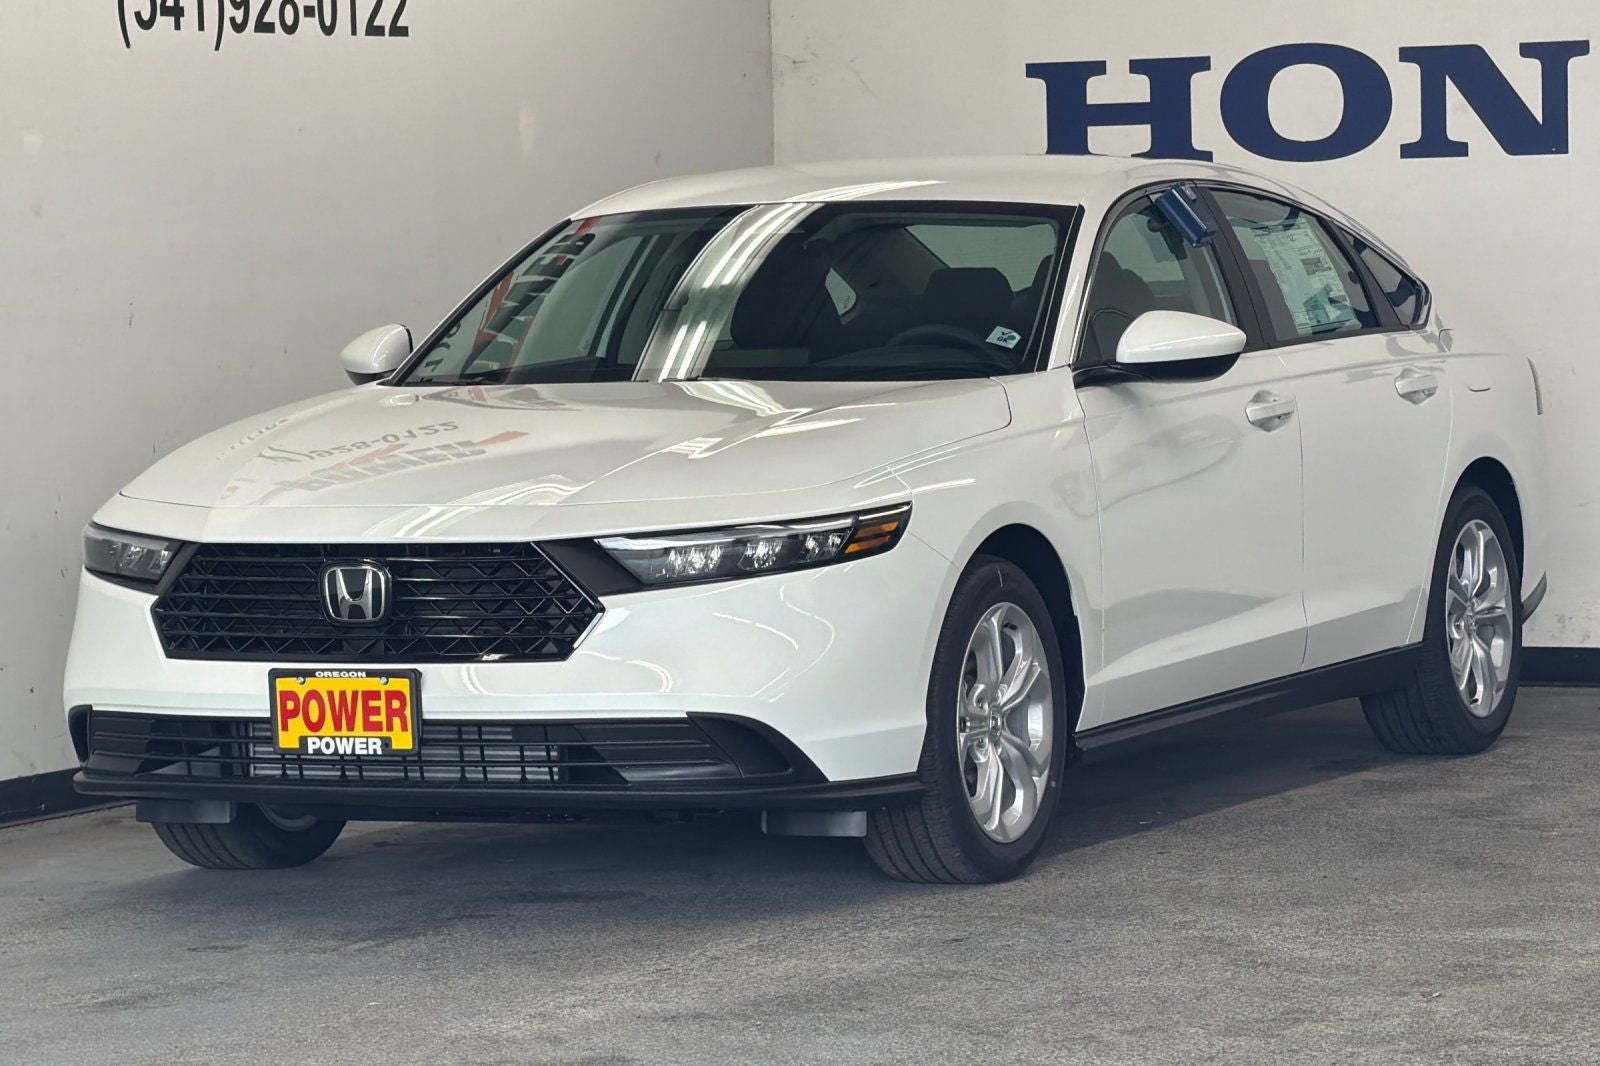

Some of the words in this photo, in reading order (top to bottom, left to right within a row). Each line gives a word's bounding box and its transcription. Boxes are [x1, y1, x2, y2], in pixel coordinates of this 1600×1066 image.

[1025, 39, 1591, 163] HON
[279, 689, 409, 733] POWER
[307, 737, 383, 755] POWER
